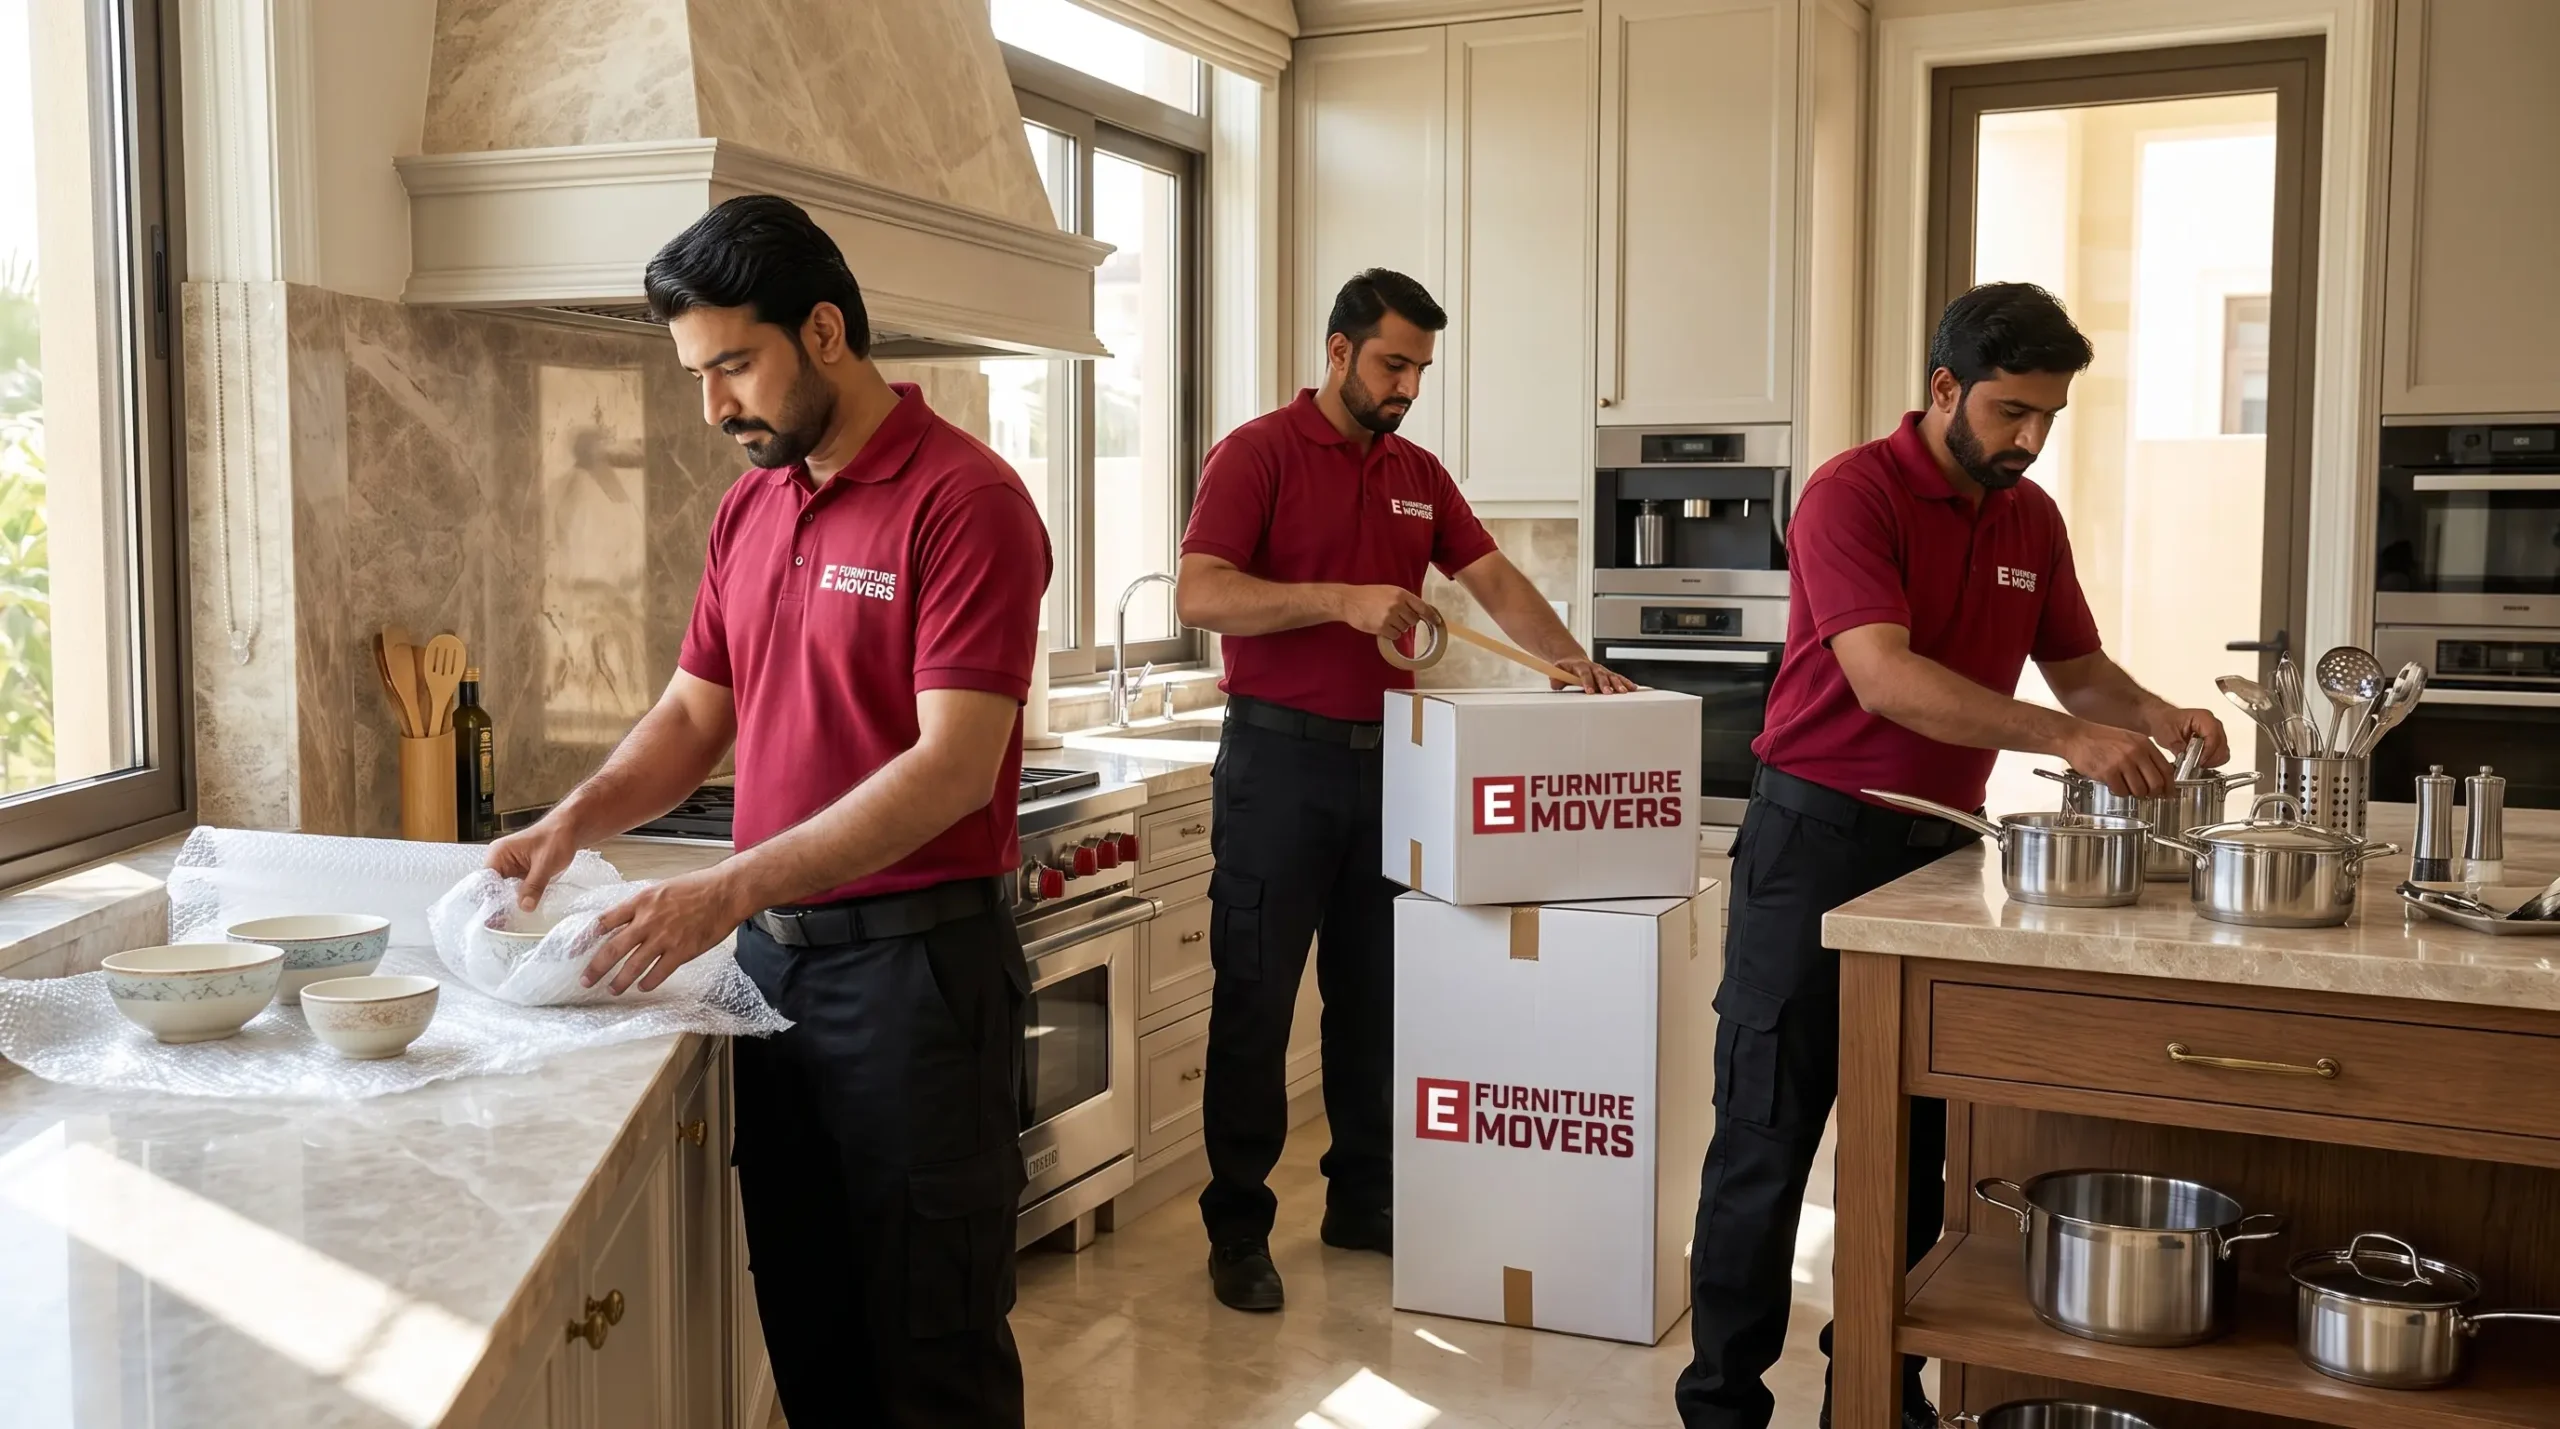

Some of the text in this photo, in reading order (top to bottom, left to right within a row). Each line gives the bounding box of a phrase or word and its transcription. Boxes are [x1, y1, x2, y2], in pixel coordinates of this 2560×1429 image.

[1391, 498, 1402, 515] E
[820, 564, 897, 589] E FURNITURE
[834, 576, 895, 601] MOVERS
[1997, 566, 2010, 586] E
[1484, 770, 1682, 826] E FURNITURE
[1531, 796, 1682, 832] MOVERS
[1427, 1083, 1634, 1132] E FURNITURE
[1475, 1111, 1634, 1158] MOVERS
